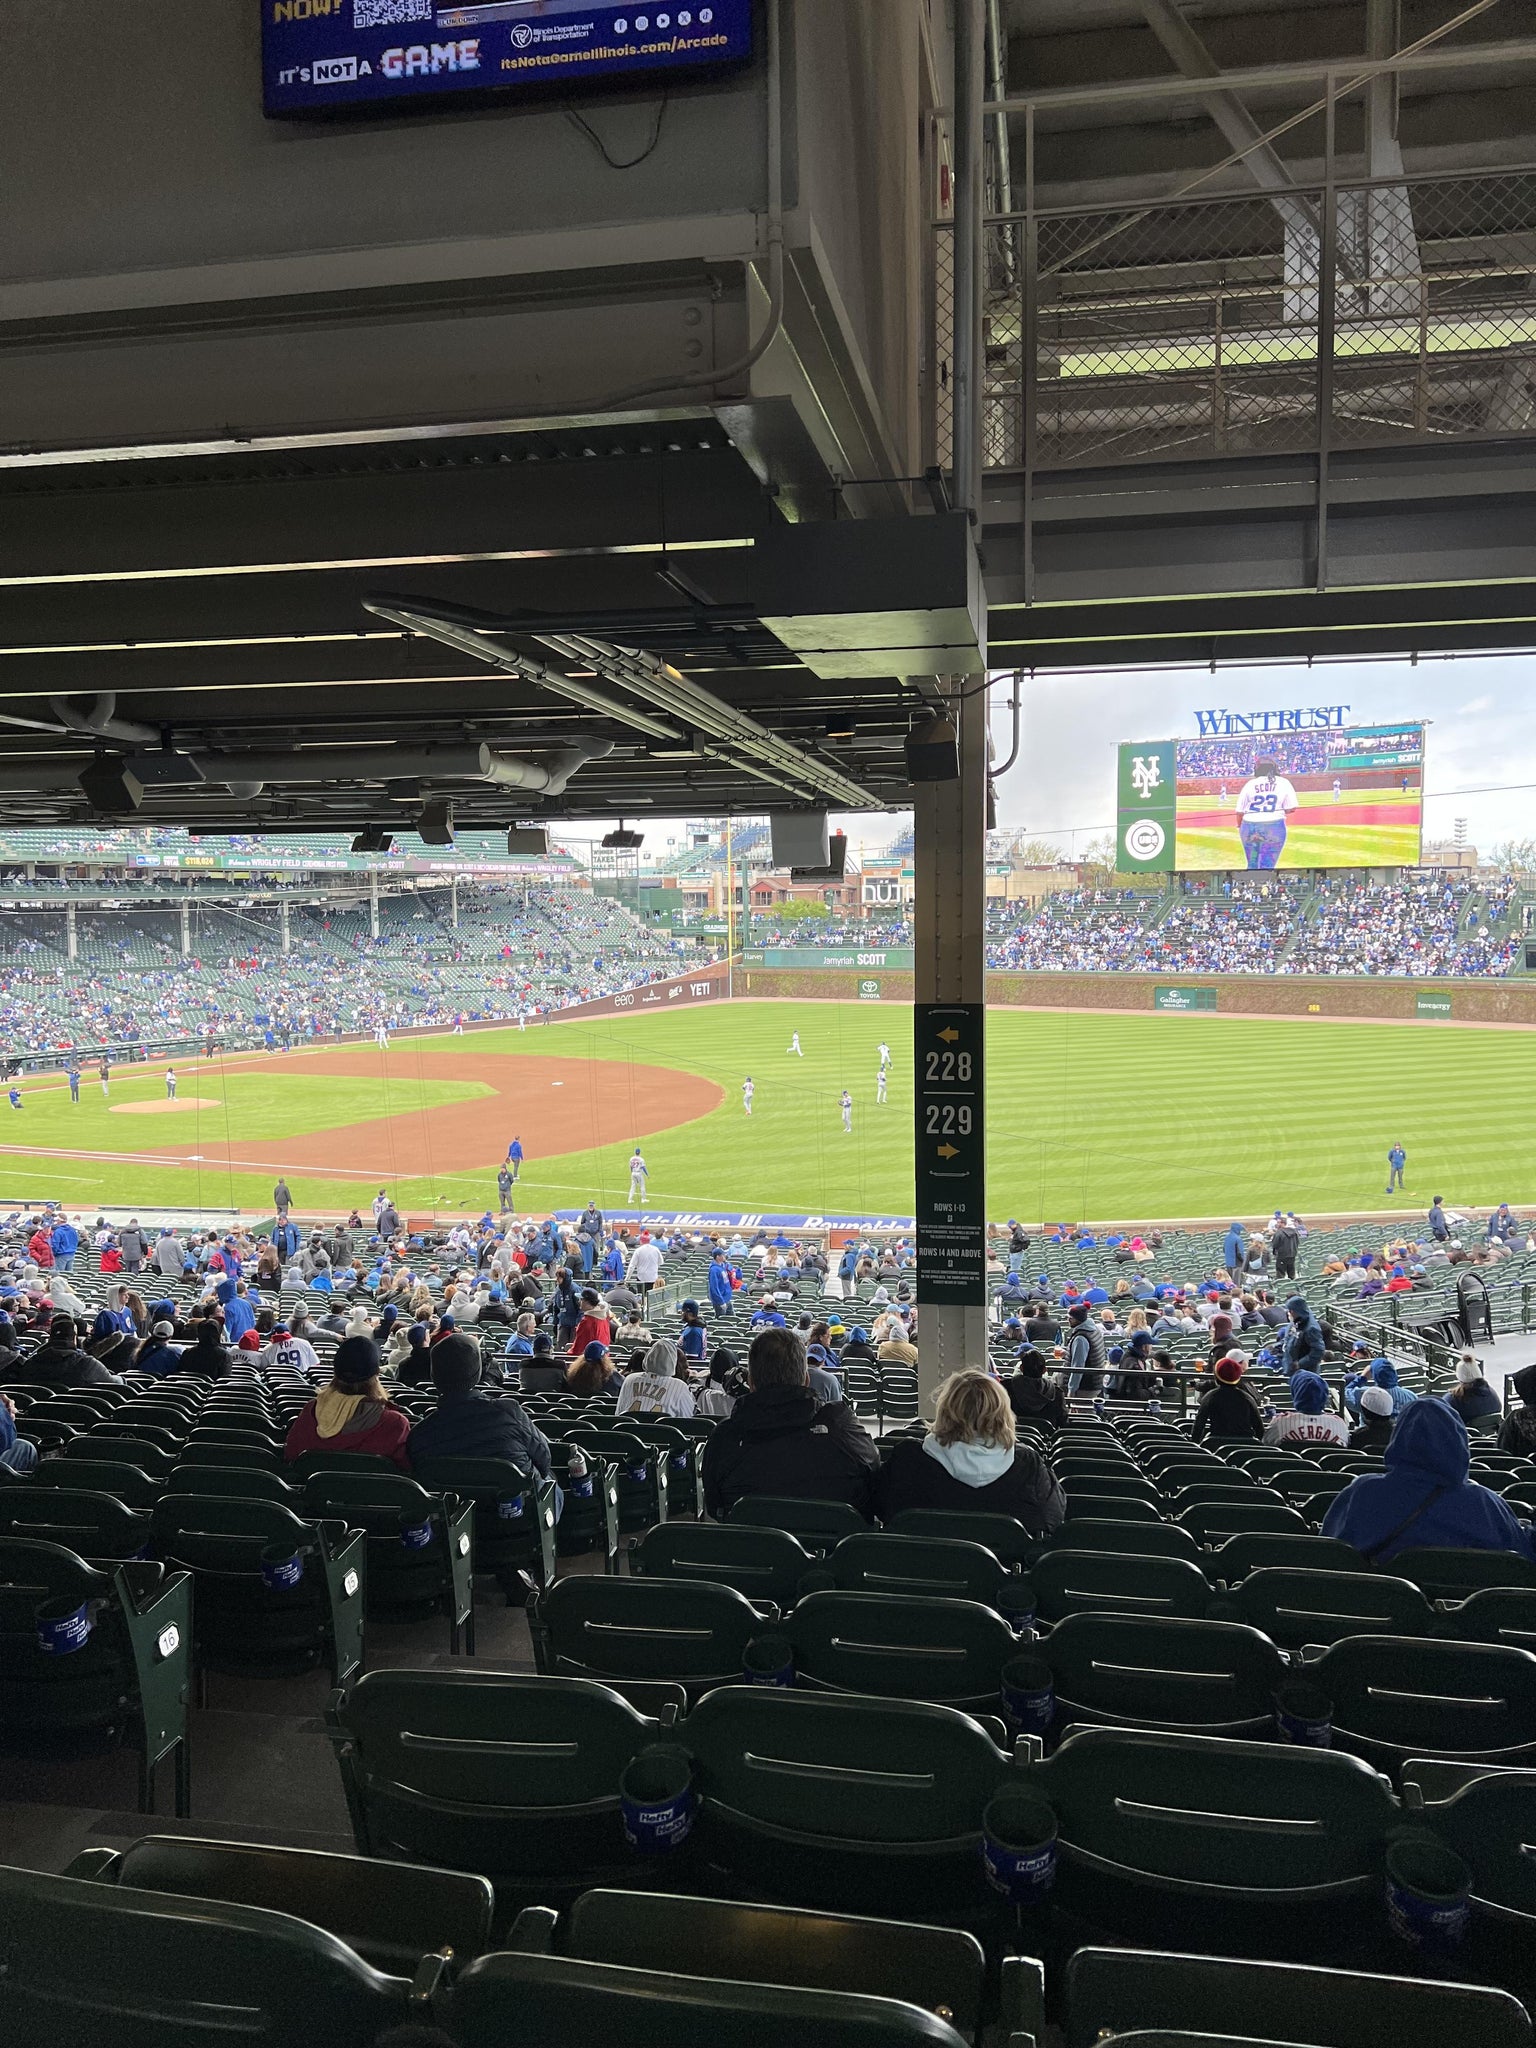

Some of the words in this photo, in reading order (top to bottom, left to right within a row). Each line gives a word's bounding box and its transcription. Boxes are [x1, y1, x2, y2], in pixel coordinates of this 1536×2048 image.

[273, 0, 340, 24] NOW!
[533, 26, 554, 36] Illinois
[554, 22, 594, 33] Department
[542, 30, 589, 41] Transportation
[279, 66, 311, 84] IT'S
[316, 62, 354, 79] NOT
[358, 60, 373, 76] A
[381, 39, 481, 80] GAME
[1194, 705, 1350, 735] WINTRUST
[1397, 753, 1421, 763] SCOTT
[1254, 782, 1277, 793] SCOTT
[1249, 794, 1278, 813] 23
[251, 859, 281, 867] WRIGLEY
[593, 855, 615, 863] TAKES
[388, 861, 405, 869] SCOTT
[744, 952, 763, 960] Harvey
[857, 954, 886, 965] SCOTT
[690, 982, 710, 996] YETI
[614, 993, 635, 1006] eero
[1160, 996, 1190, 1004] Gallagher
[1417, 1001, 1451, 1011] Invenergy
[926, 1051, 972, 1081] 228
[926, 1105, 972, 1135] 229
[934, 1203, 953, 1212] ROWS
[919, 1248, 938, 1256] ROWS
[939, 1248, 946, 1257] 14
[947, 1249, 960, 1257] AND
[961, 1249, 982, 1258] ABOVE
[633, 1382, 667, 1401] RIZZO
[347, 1574, 356, 1591] 15
[163, 1631, 176, 1650] 16
[641, 1811, 671, 1822] Hefty
